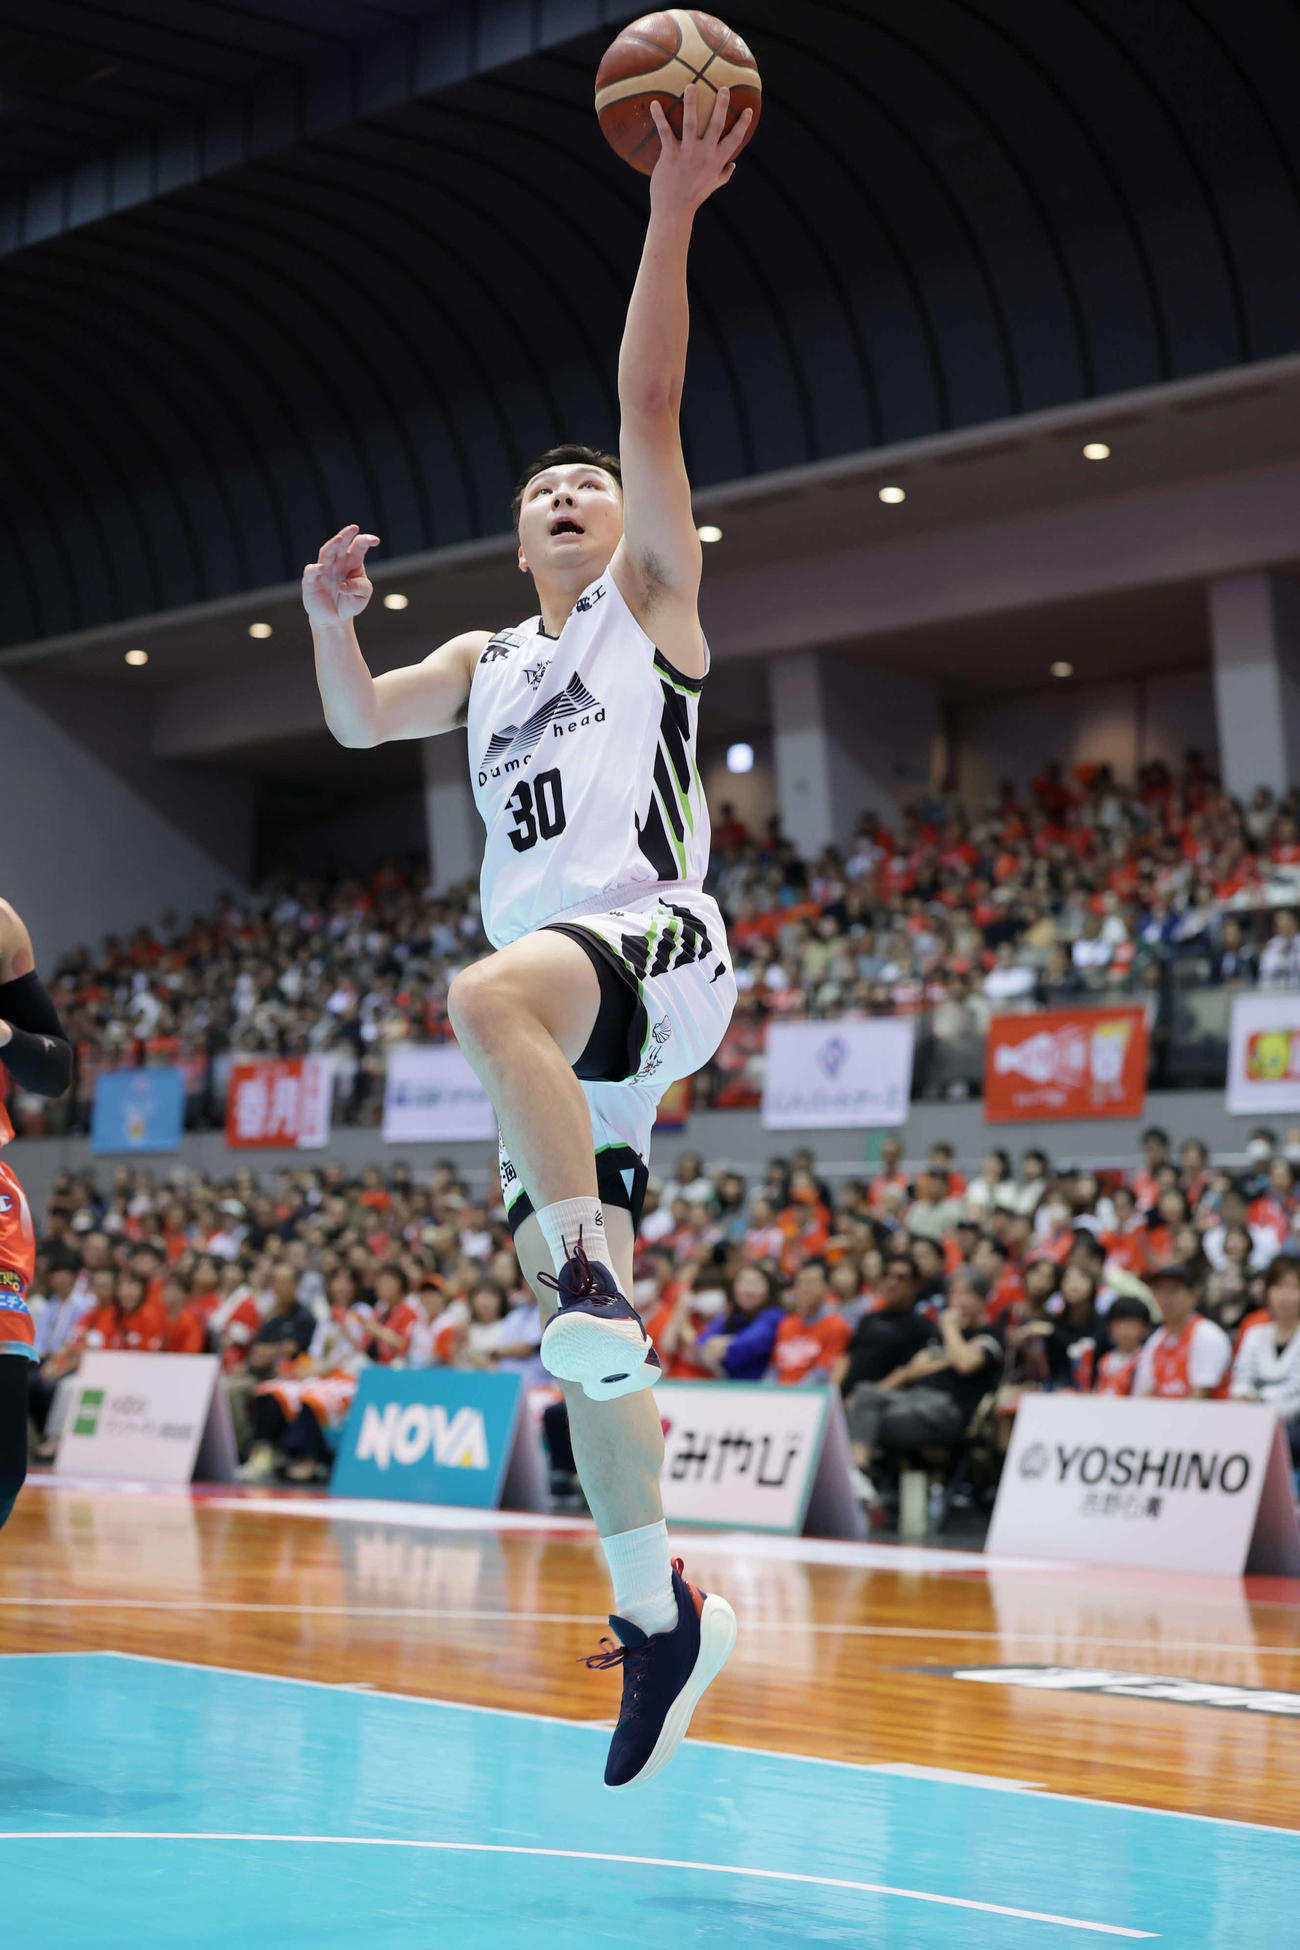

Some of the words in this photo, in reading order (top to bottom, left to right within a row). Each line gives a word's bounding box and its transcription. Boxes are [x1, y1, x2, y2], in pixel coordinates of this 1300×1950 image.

[570, 584, 606, 614] 電工
[553, 708, 606, 737] head
[504, 767, 566, 853] 30
[355, 1402, 490, 1471] NOVA
[670, 1426, 801, 1488] みやび
[1055, 1444, 1251, 1494] YOSHINO
